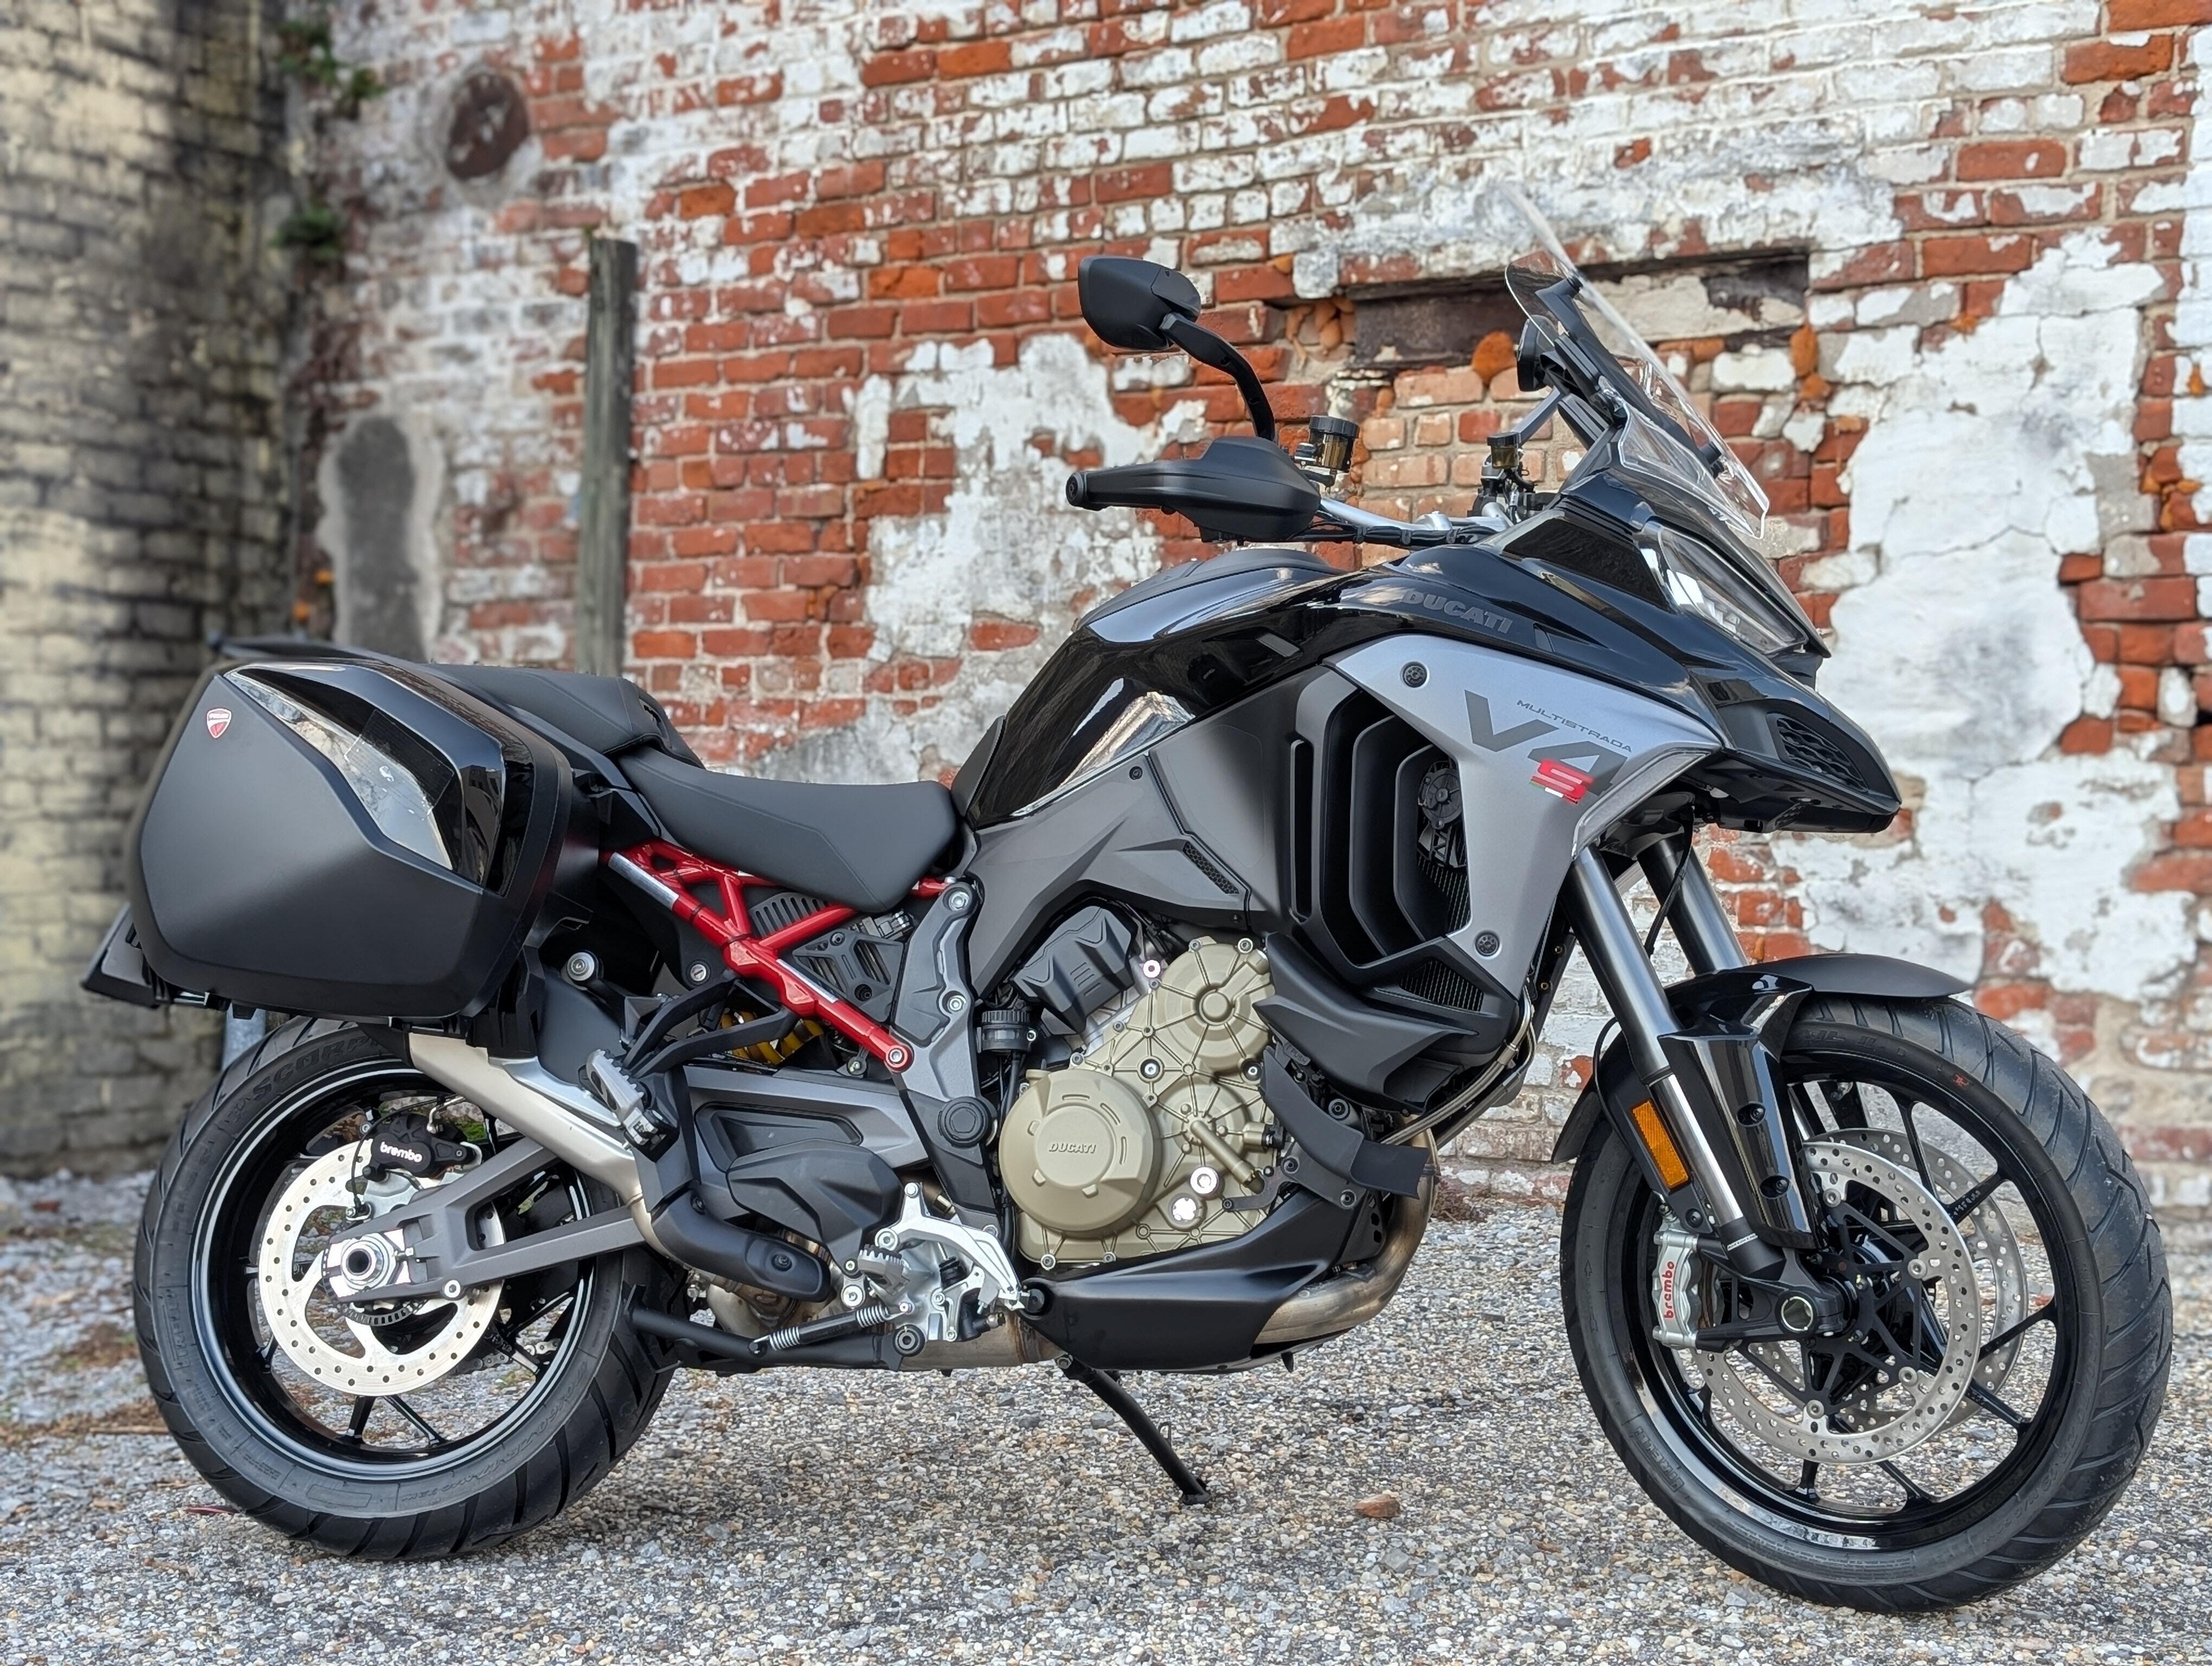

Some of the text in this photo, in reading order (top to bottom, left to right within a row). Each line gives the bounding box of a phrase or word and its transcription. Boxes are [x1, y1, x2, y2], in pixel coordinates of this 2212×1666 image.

[1401, 589, 1513, 634] DUCATI
[1464, 689, 1628, 796] V4
[1517, 700, 1632, 753] MULTISTRADA
[1530, 759, 1595, 800] S
[380, 1142, 422, 1162] brembo
[1048, 1142, 1097, 1154] DUCATI
[1662, 1261, 1675, 1318] brembo
